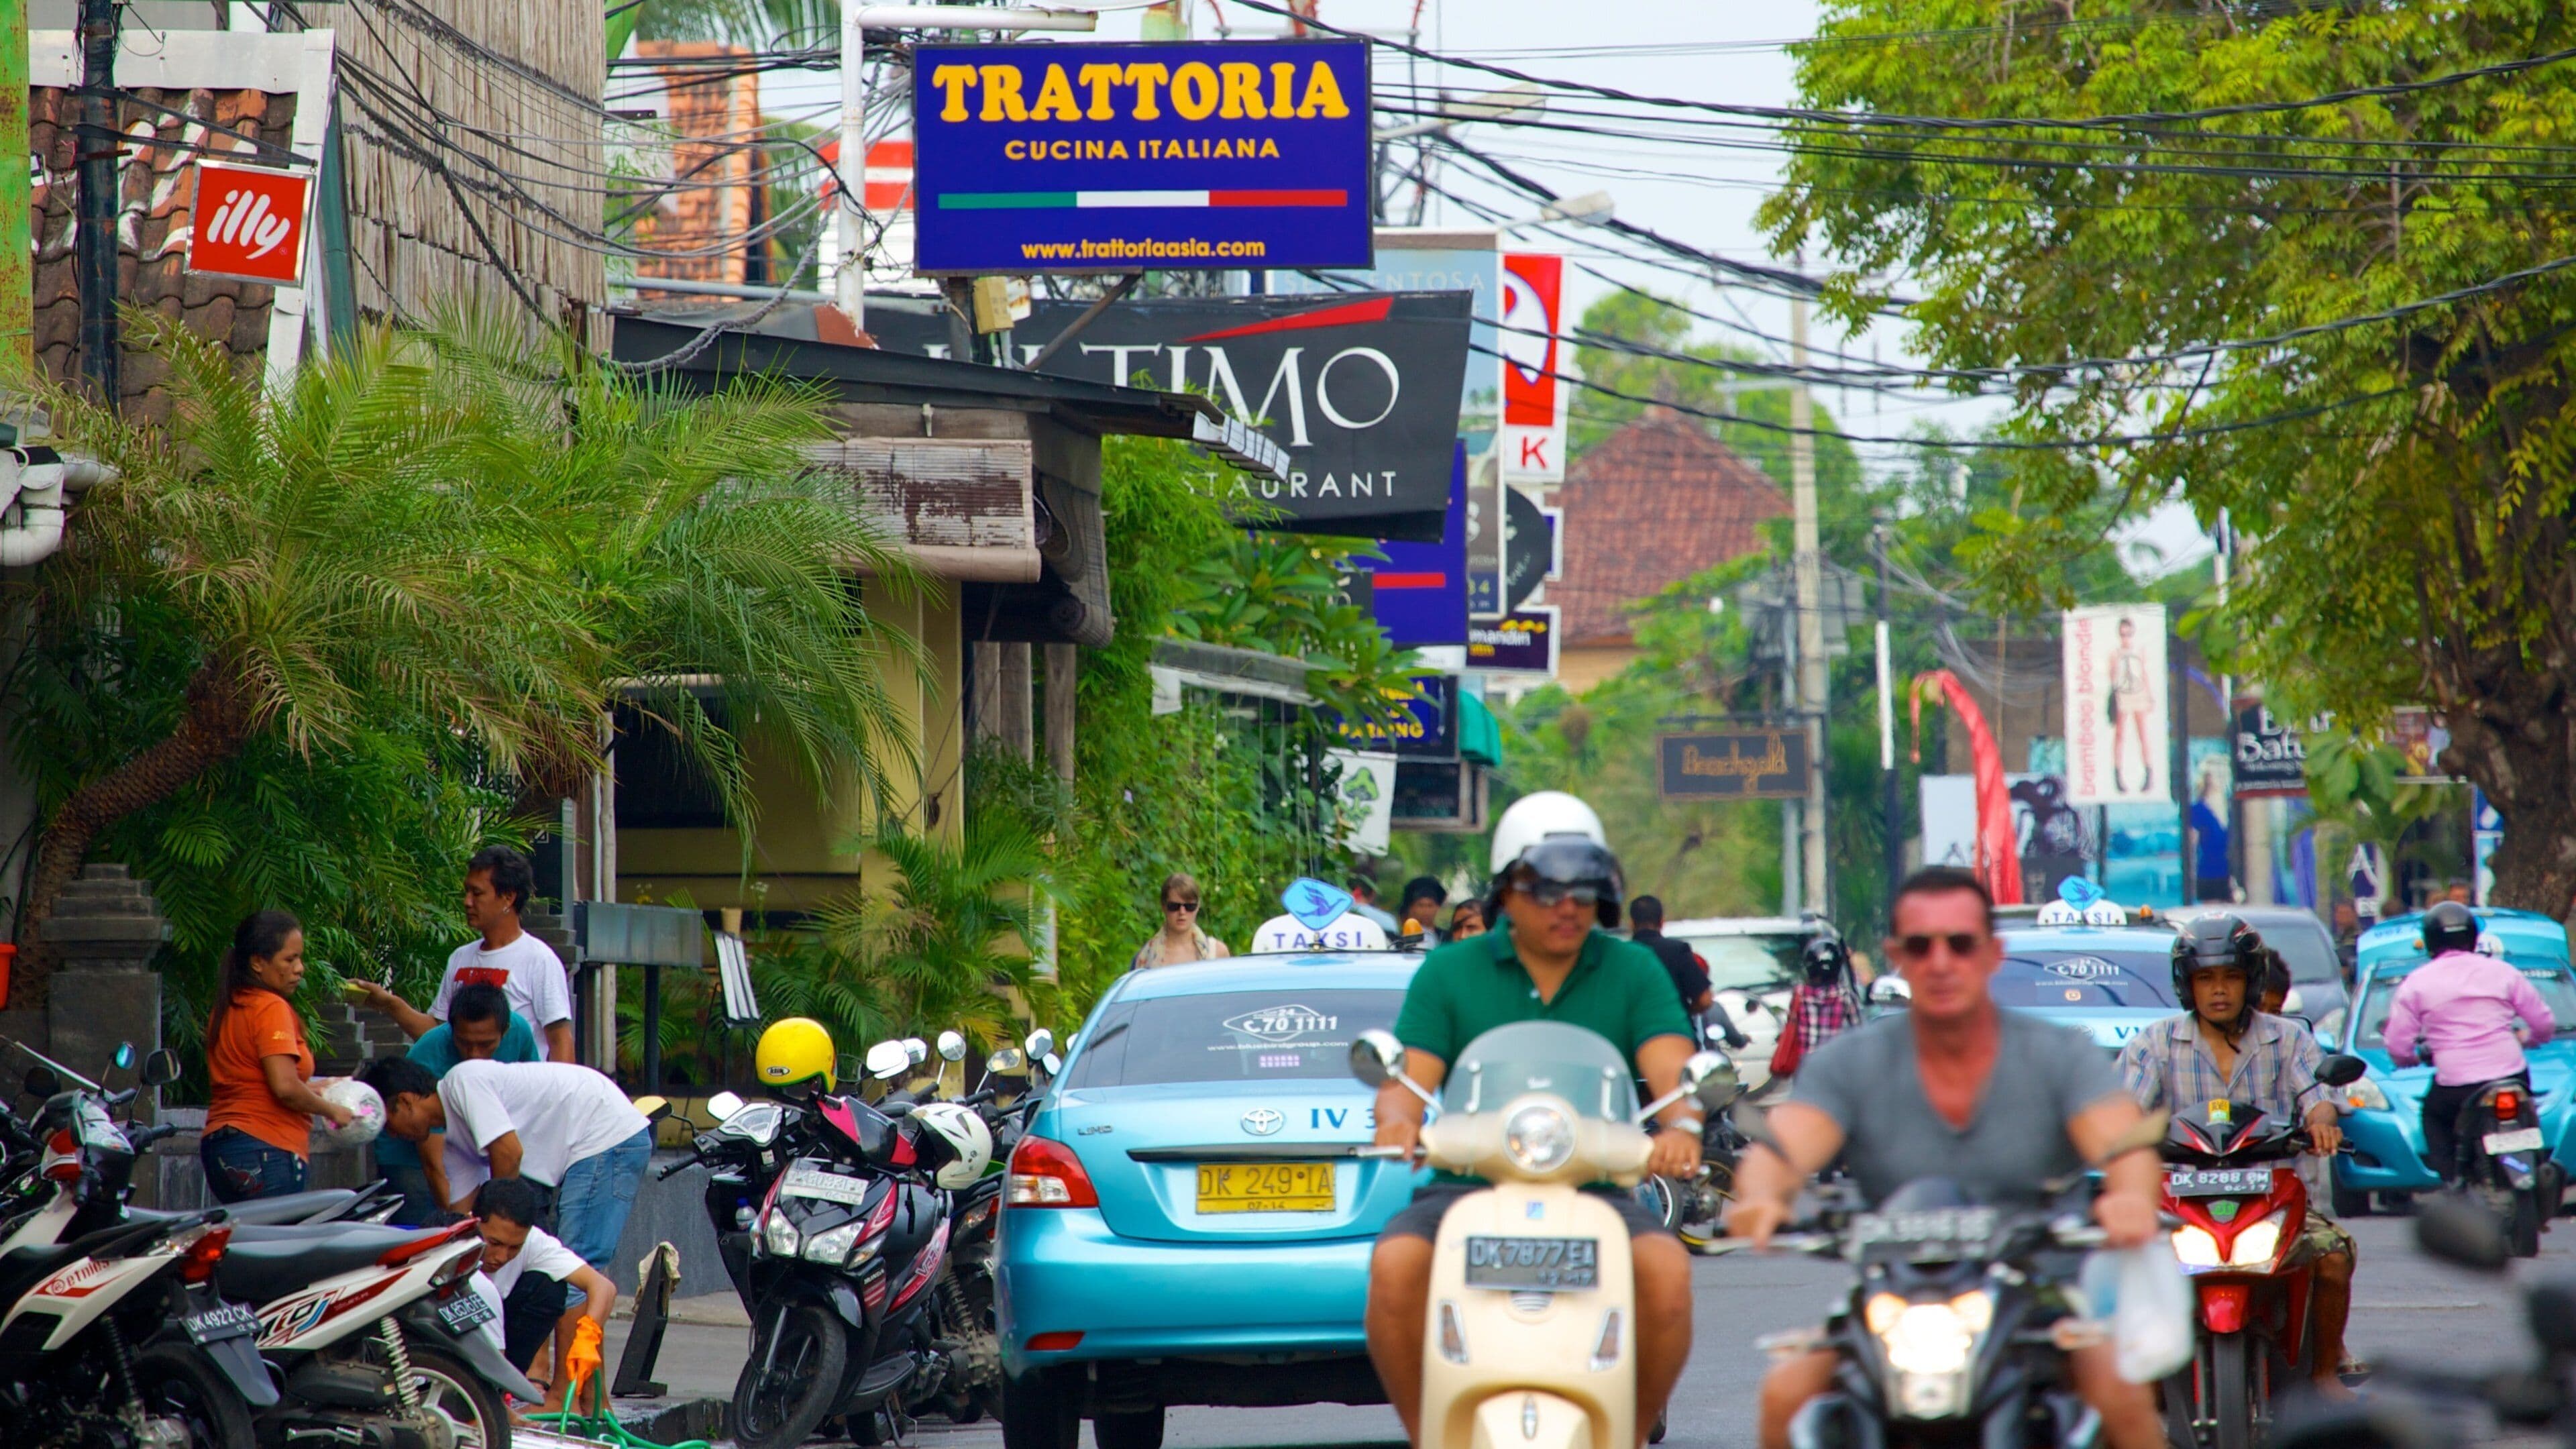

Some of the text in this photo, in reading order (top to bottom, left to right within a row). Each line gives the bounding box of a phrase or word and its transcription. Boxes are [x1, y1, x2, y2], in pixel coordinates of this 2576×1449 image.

[932, 60, 1350, 122] TRATTORIA
[1005, 138, 1281, 160] CUCINA ITALIANA
[207, 189, 290, 260] illy
[1021, 237, 1266, 259] www.trattoriaasia.com
[1362, 271, 1485, 291] ENTOSA
[922, 343, 1401, 447] TIMO
[1177, 471, 1397, 499] TAURANT
[2053, 912, 2111, 924] TASI
[1273, 931, 1361, 949] TAKSI
[1263, 1016, 1338, 1032] 70 1111
[1311, 1108, 1348, 1129] IV
[1198, 1168, 1232, 1195] DK
[1245, 1166, 1293, 1195] 249
[2172, 1172, 2194, 1186] DK
[1470, 1238, 1502, 1266] DK
[1505, 1240, 1565, 1267] 7877
[188, 1314, 207, 1332] DK
[203, 1307, 236, 1328] 4922
[232, 1304, 254, 1322] CK
